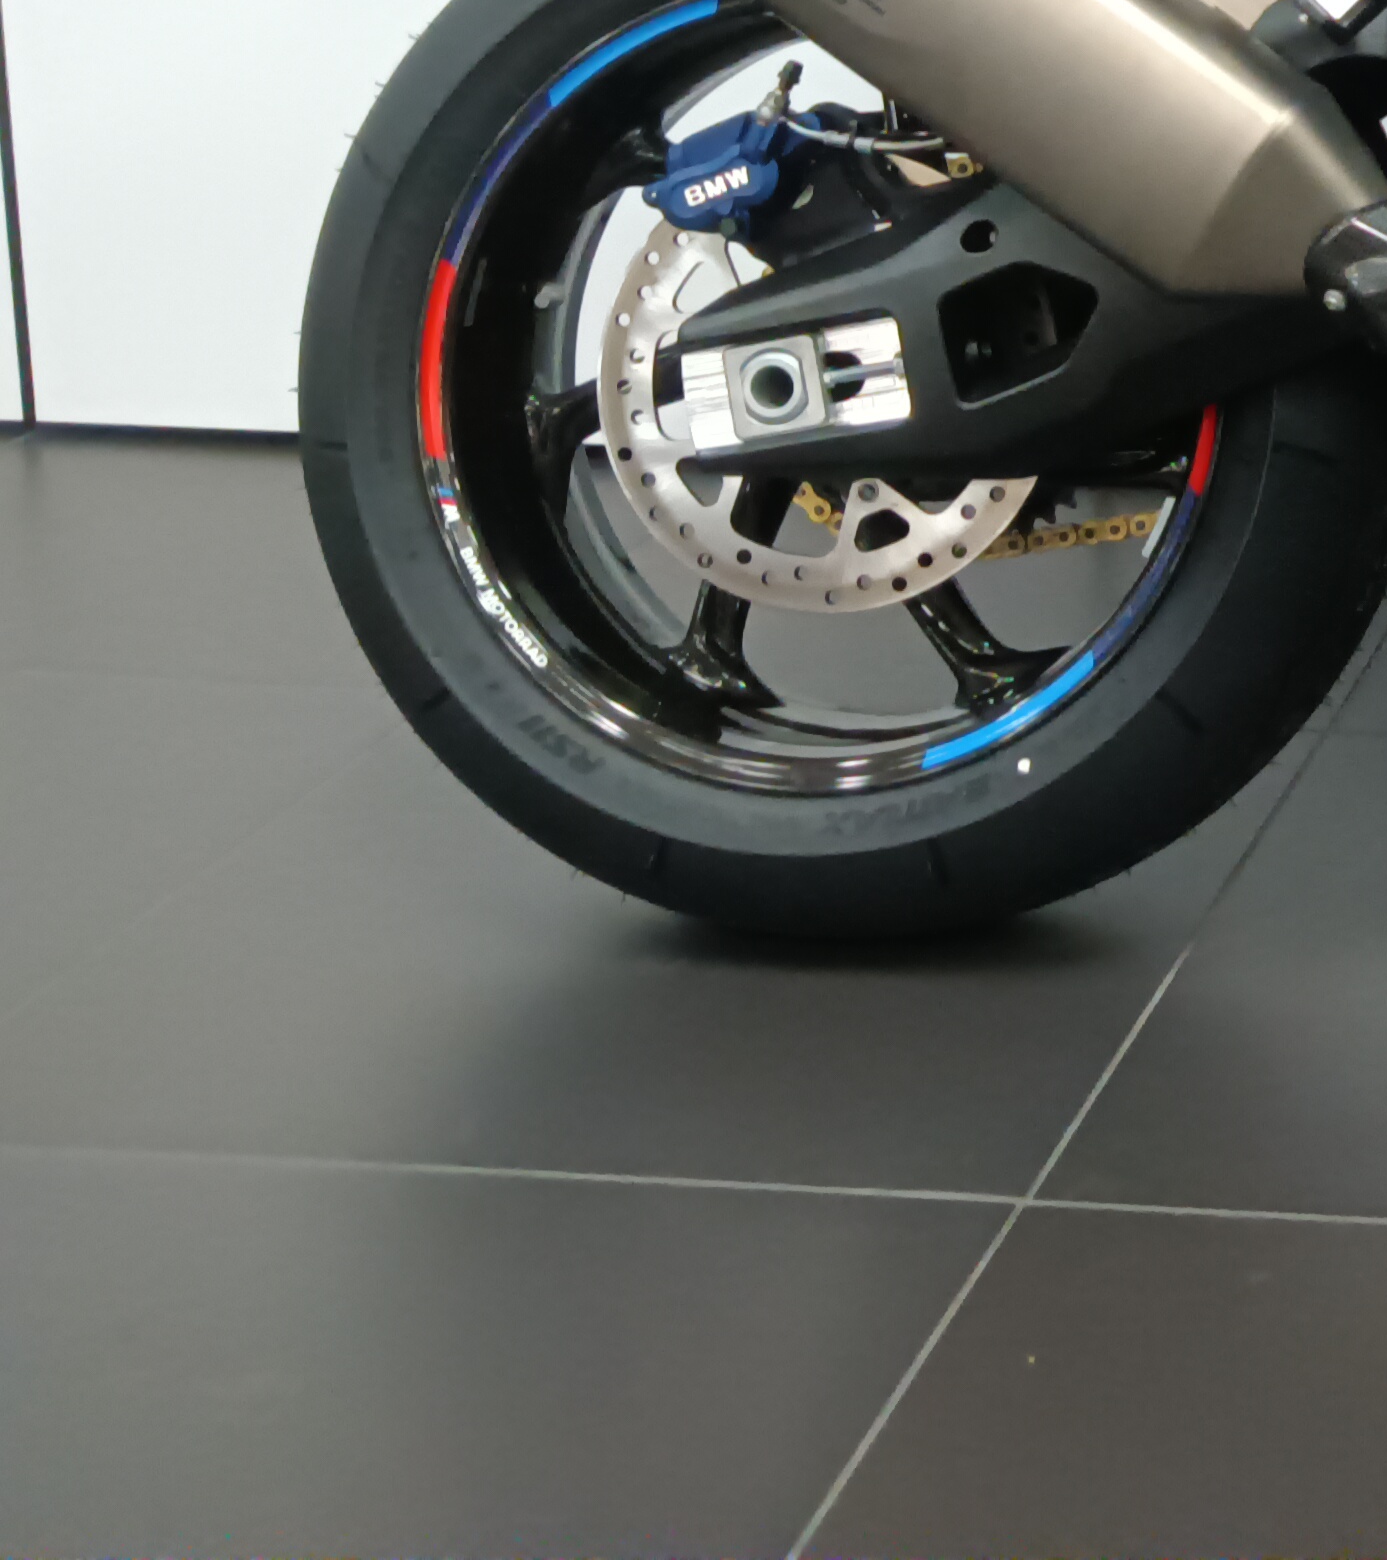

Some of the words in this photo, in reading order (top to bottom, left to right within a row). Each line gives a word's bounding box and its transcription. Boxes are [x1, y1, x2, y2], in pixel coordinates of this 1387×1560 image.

[684, 165, 749, 207] BMW
[460, 546, 489, 587] BMW
[480, 588, 548, 668] MOTORRAD
